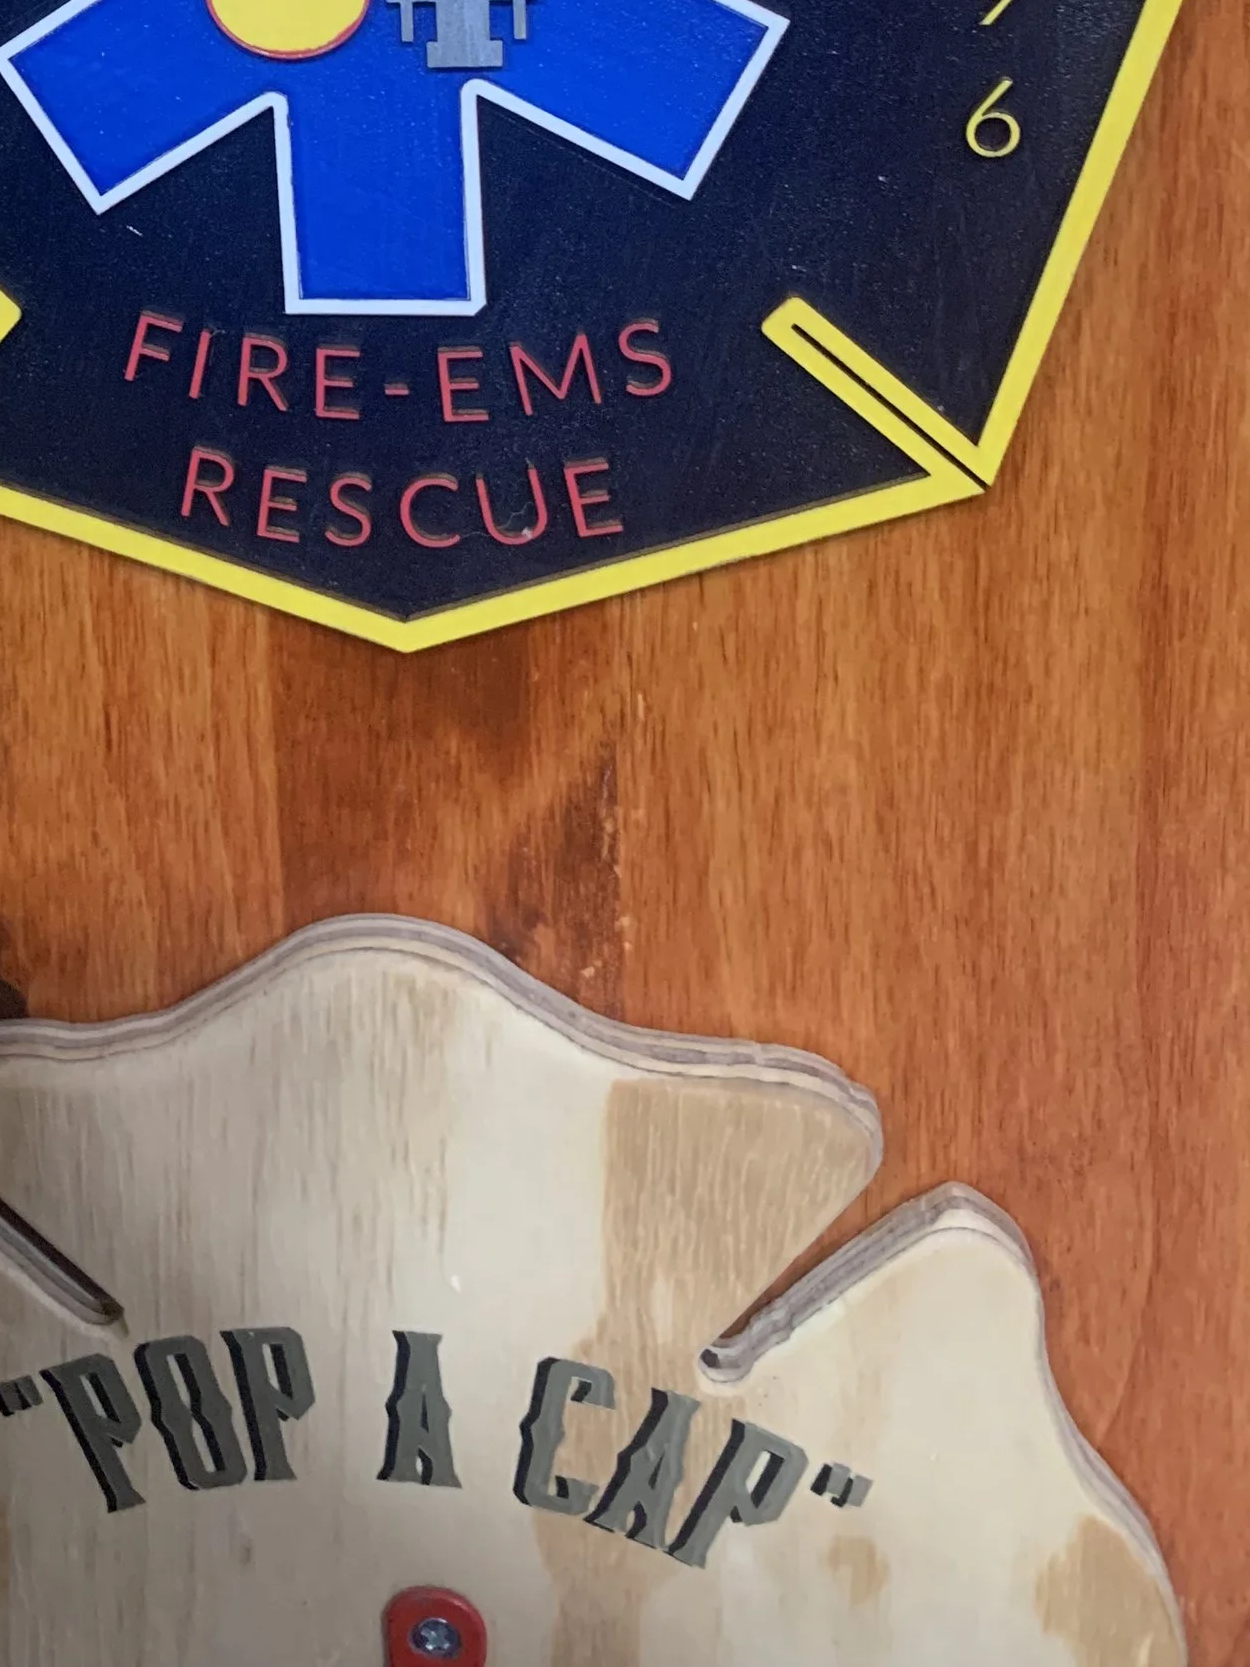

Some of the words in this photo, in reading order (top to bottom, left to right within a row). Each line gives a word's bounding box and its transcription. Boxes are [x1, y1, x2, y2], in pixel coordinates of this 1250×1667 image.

[123, 310, 672, 423] FIRE-EMS
[180, 445, 623, 548] RESCUE
[377, 1329, 463, 1490] A
[512, 1355, 874, 1569] CAP"
